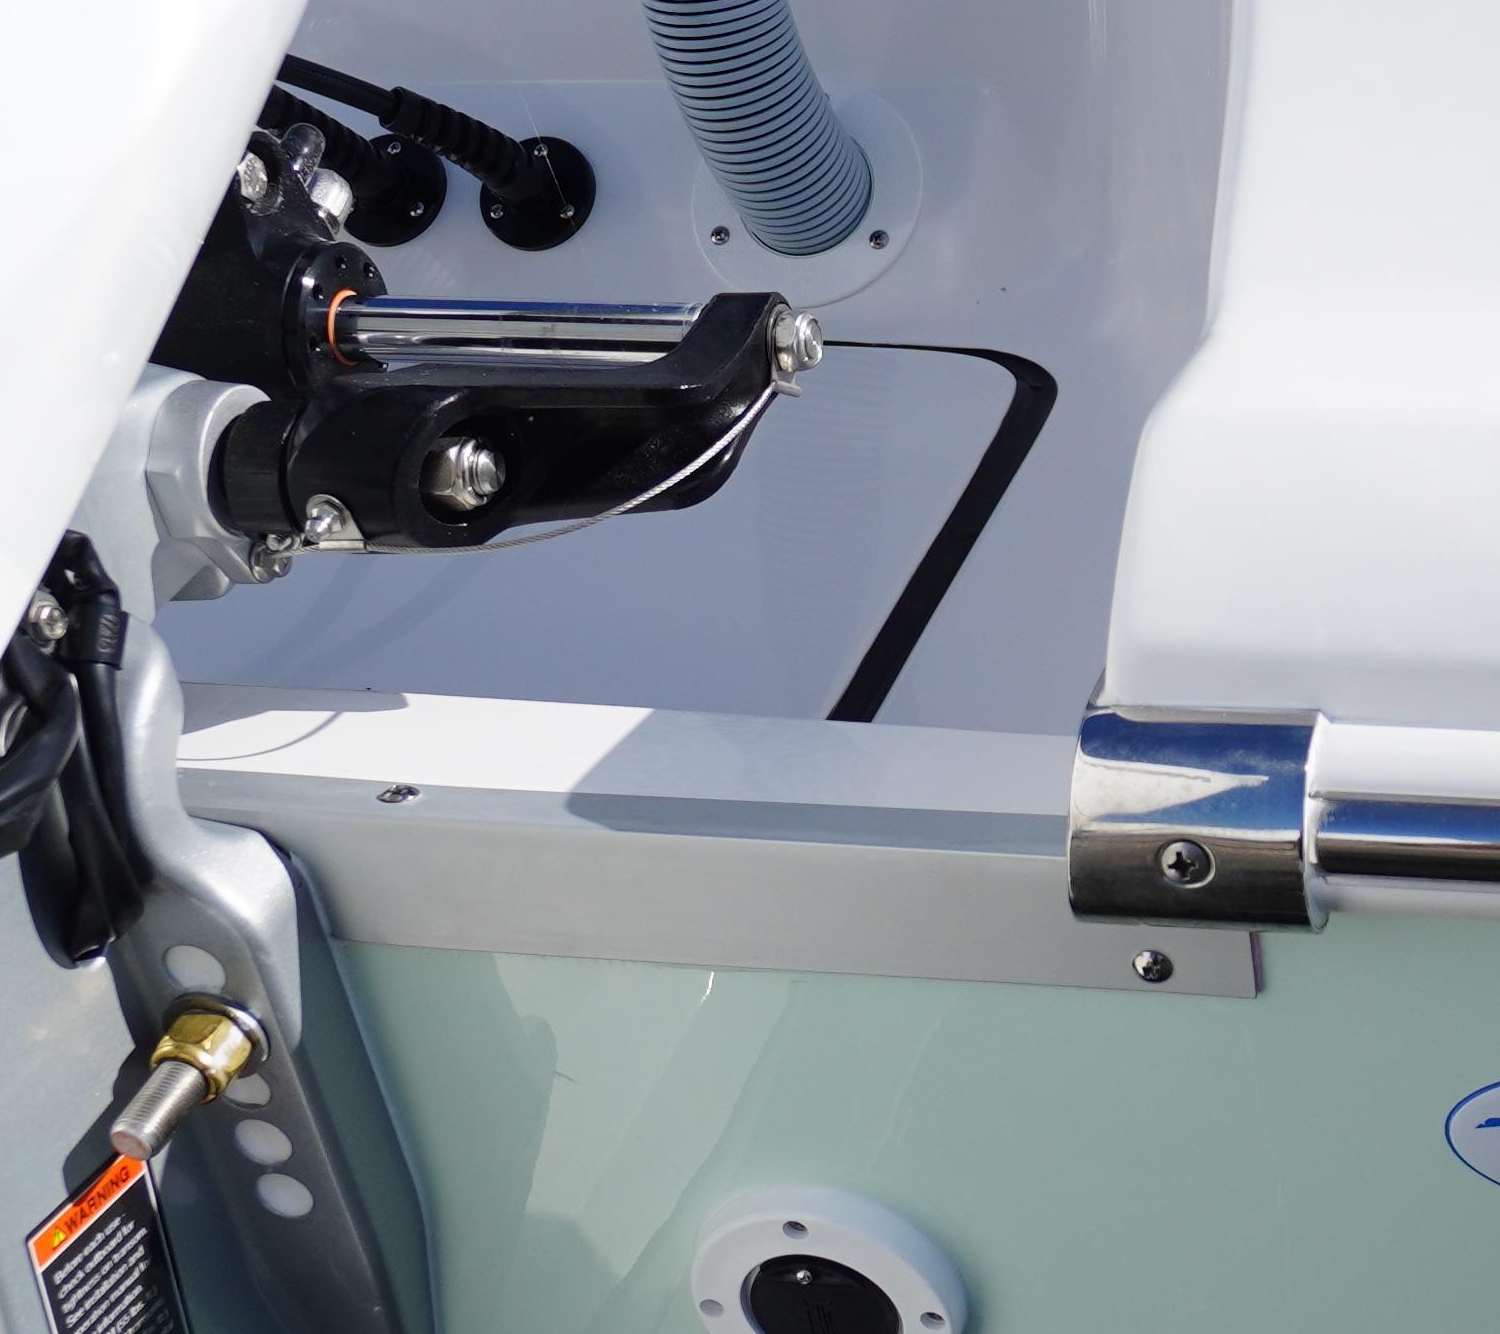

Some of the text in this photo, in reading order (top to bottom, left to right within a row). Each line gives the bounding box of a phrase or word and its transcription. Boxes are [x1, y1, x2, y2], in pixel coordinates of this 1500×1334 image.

[64, 1166, 130, 1234] WARNING
[53, 1253, 83, 1285] Before
[83, 1232, 105, 1256] each
[58, 1269, 85, 1299] check
[84, 1230, 123, 1273] outboard
